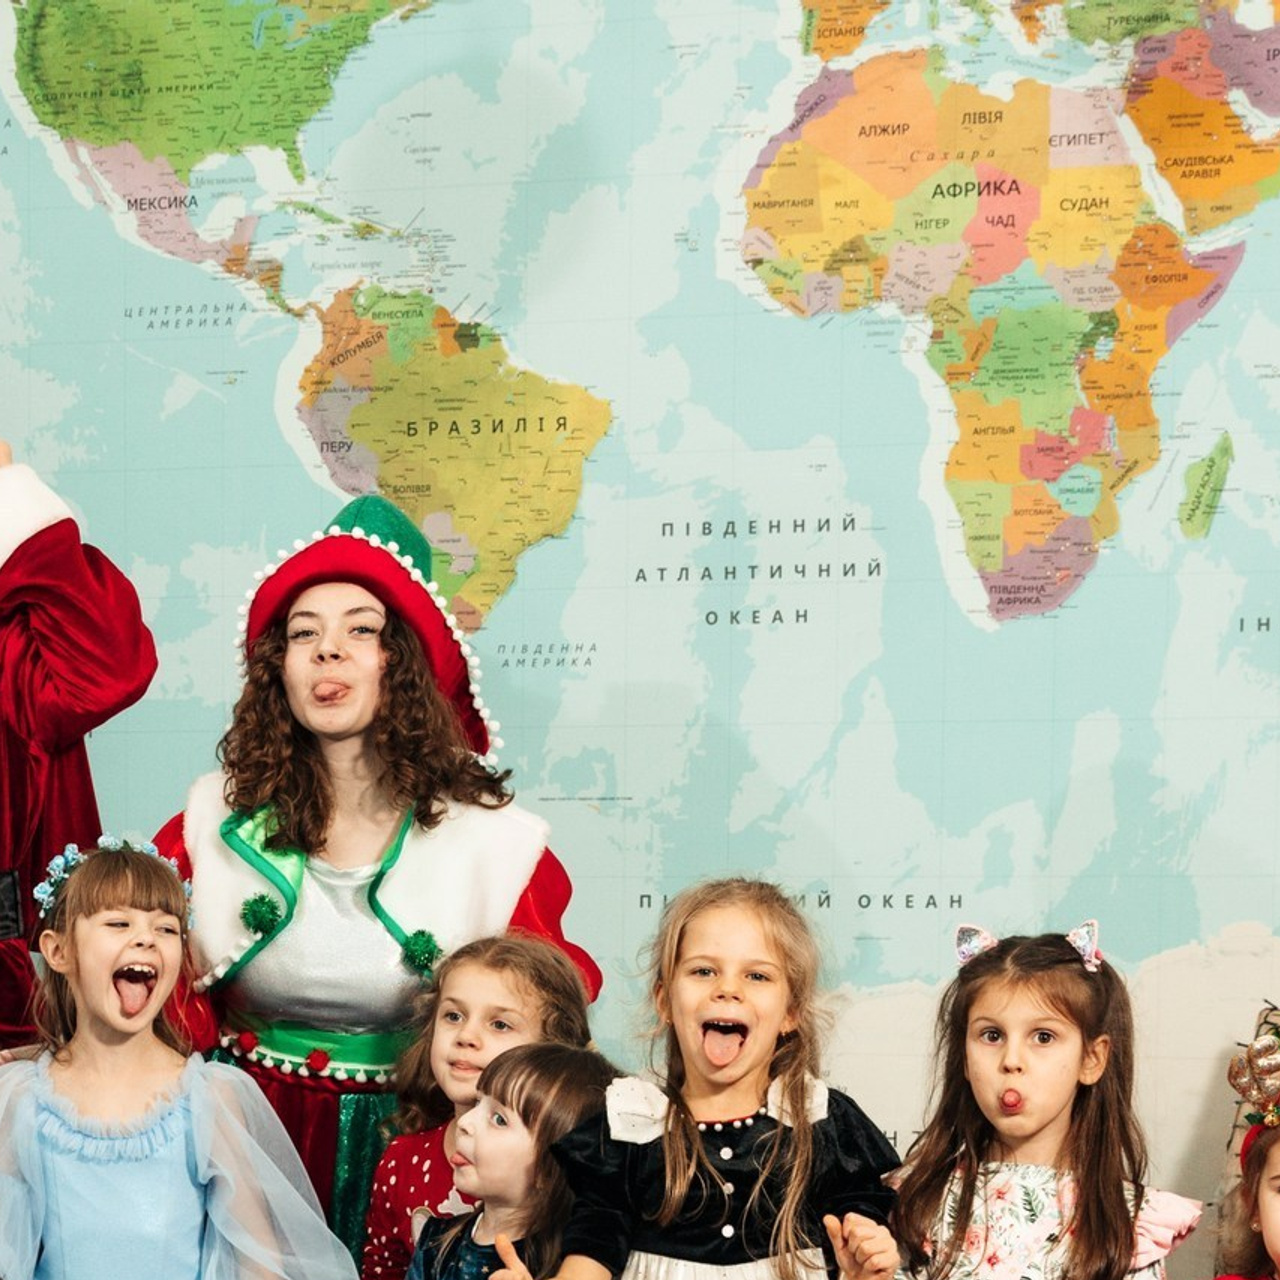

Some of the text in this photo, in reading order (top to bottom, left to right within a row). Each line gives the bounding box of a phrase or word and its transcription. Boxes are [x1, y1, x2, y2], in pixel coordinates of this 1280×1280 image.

[817, 27, 865, 39] ІСПАНІЯ
[788, 94, 827, 133] МАРОККО
[961, 110, 1004, 125] ЛІВІЯ
[858, 123, 910, 137] АЛЖИР
[1048, 132, 1105, 148] ЄГИПЕТ
[910, 149, 995, 162] Сахара
[1164, 154, 1235, 168] САУДІВСЬКА
[1180, 168, 1221, 179] АРАВІЯ
[931, 179, 1021, 199] АФРИКА
[126, 196, 199, 211] МЕКСИКА
[752, 198, 814, 209] МАВРИТАНІЯ
[834, 200, 860, 209] МАЛІ
[1059, 198, 1109, 212] СУДАН
[914, 218, 950, 230] НІГЕР
[985, 214, 1016, 228] ЧАД
[124, 302, 248, 317] ЦЕНТРАЛЬНА
[371, 310, 424, 320] ВЕНЕСУЕЛА
[147, 317, 233, 330] АМЕРИКА
[329, 330, 385, 367] КОЛУМБІЯ
[406, 417, 568, 437] БРАЗИЛІЯ
[320, 440, 353, 454] ПЕРУ
[662, 513, 856, 538] ПІВДЕННИЙ
[635, 558, 881, 582] АТЛАНТИЧНИЙ
[989, 584, 1046, 595] ПІВДЕННА
[997, 596, 1043, 605] АФРИКА
[705, 609, 808, 625] ОКЕАН
[497, 643, 597, 655] ПІВДЕННА
[502, 656, 592, 668] АМЕРИКА
[858, 894, 963, 909] ОКЕАН
